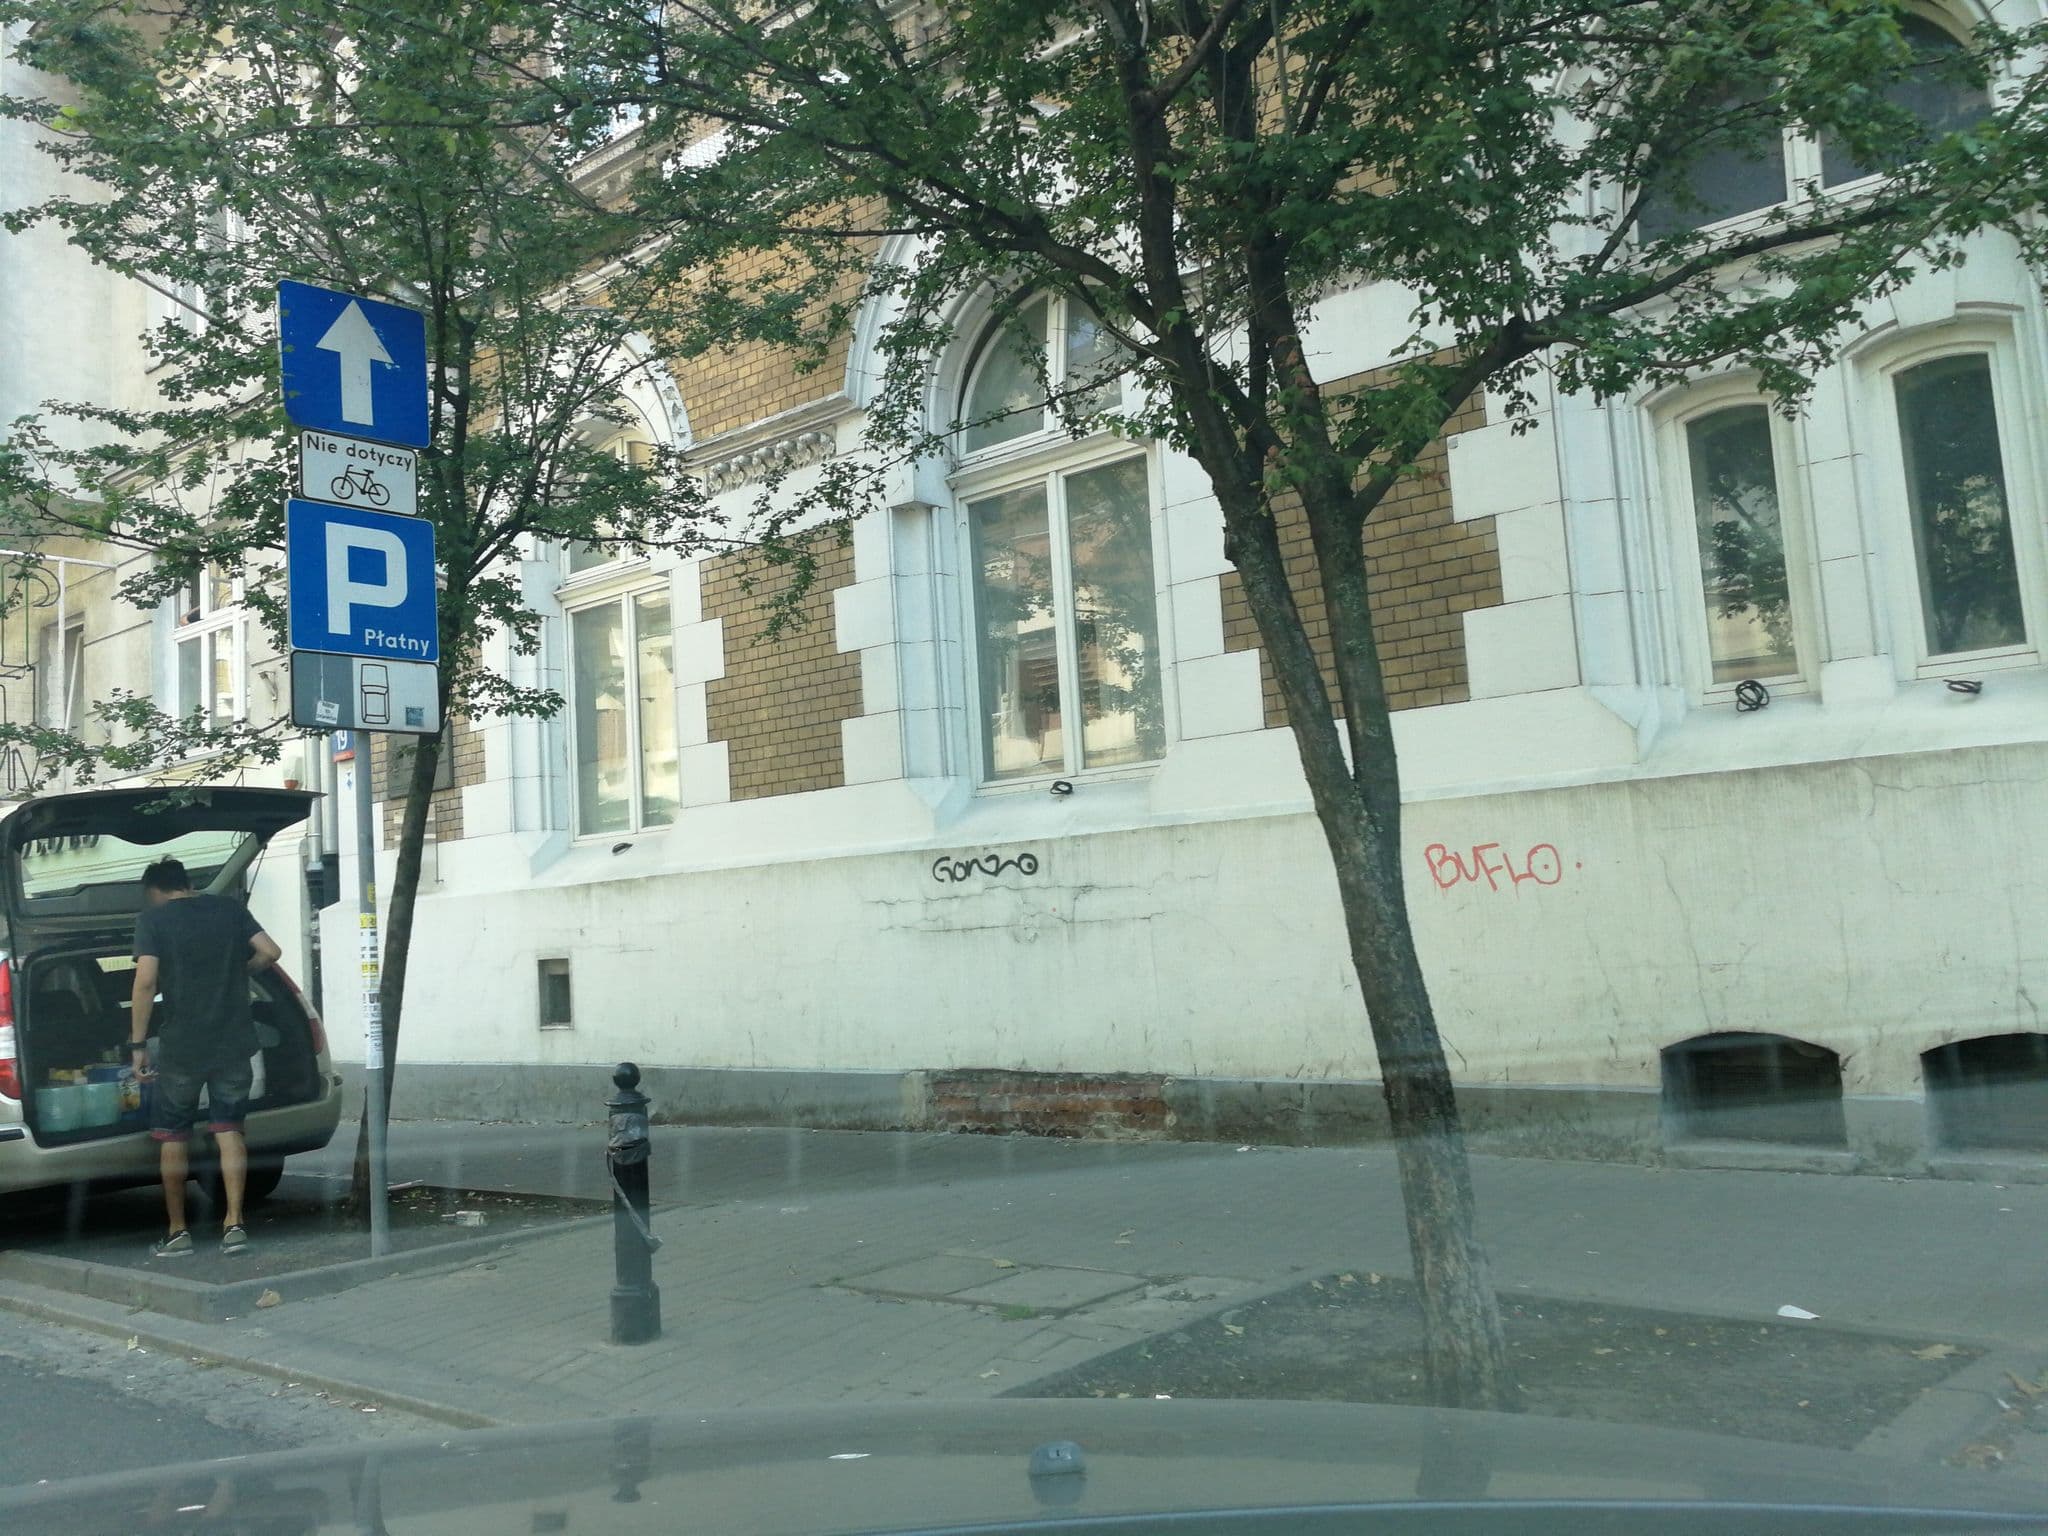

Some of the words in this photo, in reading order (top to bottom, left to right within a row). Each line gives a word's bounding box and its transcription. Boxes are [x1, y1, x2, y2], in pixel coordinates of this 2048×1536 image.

[306, 434, 338, 454] Nie
[346, 443, 412, 472] dotyczy
[325, 521, 408, 635] P
[364, 628, 430, 656] Płatny
